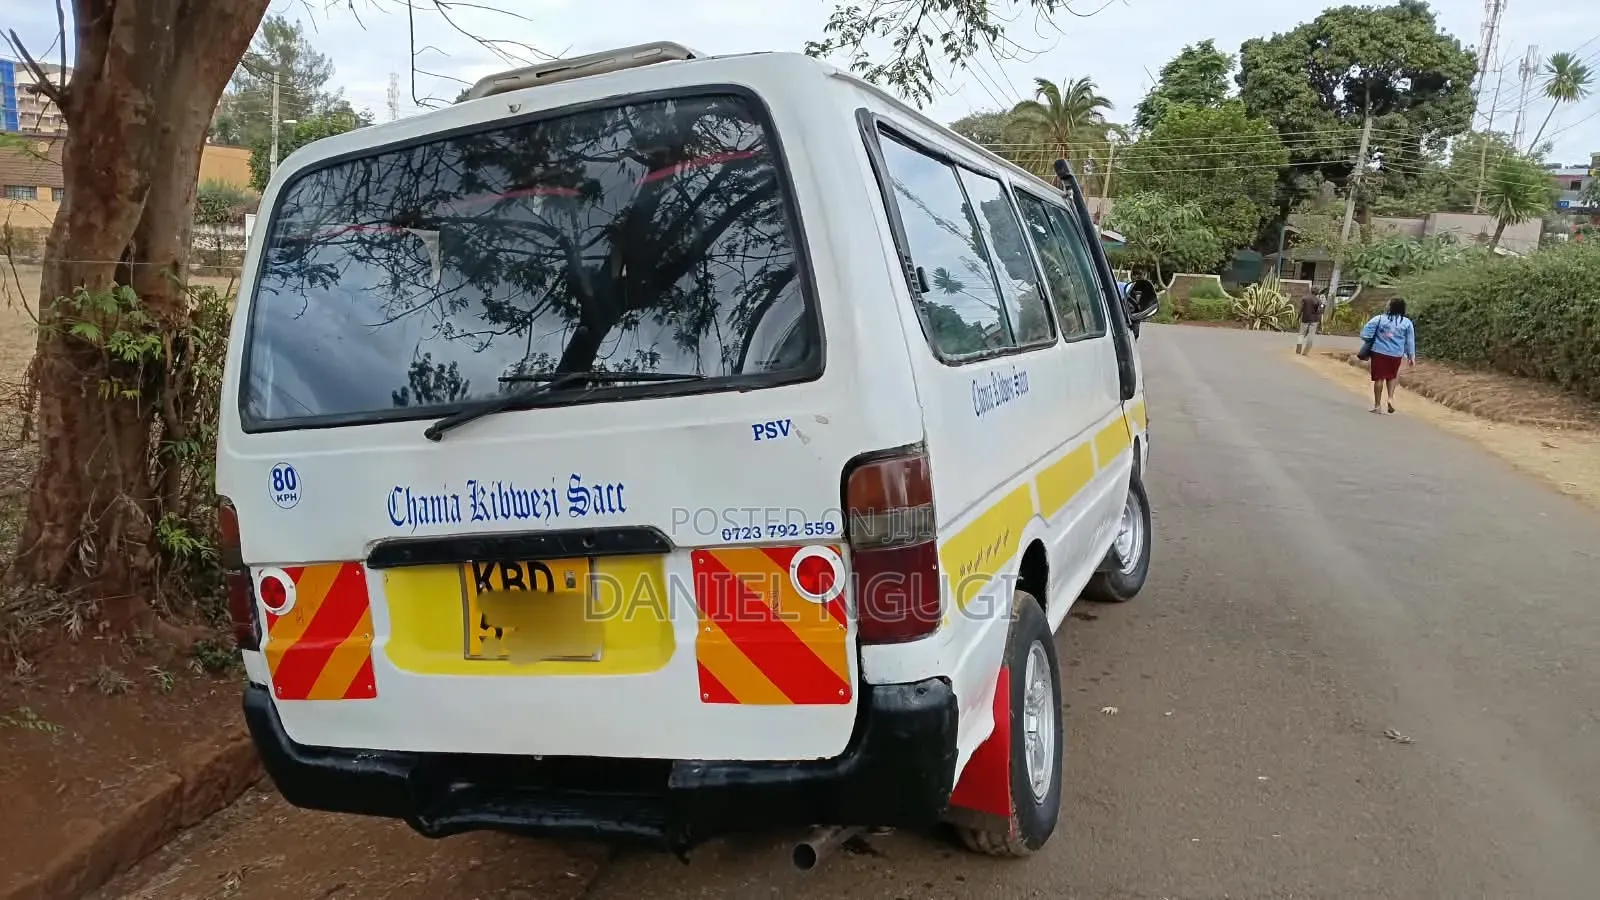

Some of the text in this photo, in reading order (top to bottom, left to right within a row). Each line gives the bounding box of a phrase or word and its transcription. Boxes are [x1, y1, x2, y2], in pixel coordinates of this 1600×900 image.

[751, 419, 791, 441] PSV
[272, 467, 297, 492] 80
[276, 493, 297, 503] KPH
[387, 483, 462, 534] Chania
[466, 476, 560, 527] Kibwezi
[721, 521, 835, 542] 0723 792 559
